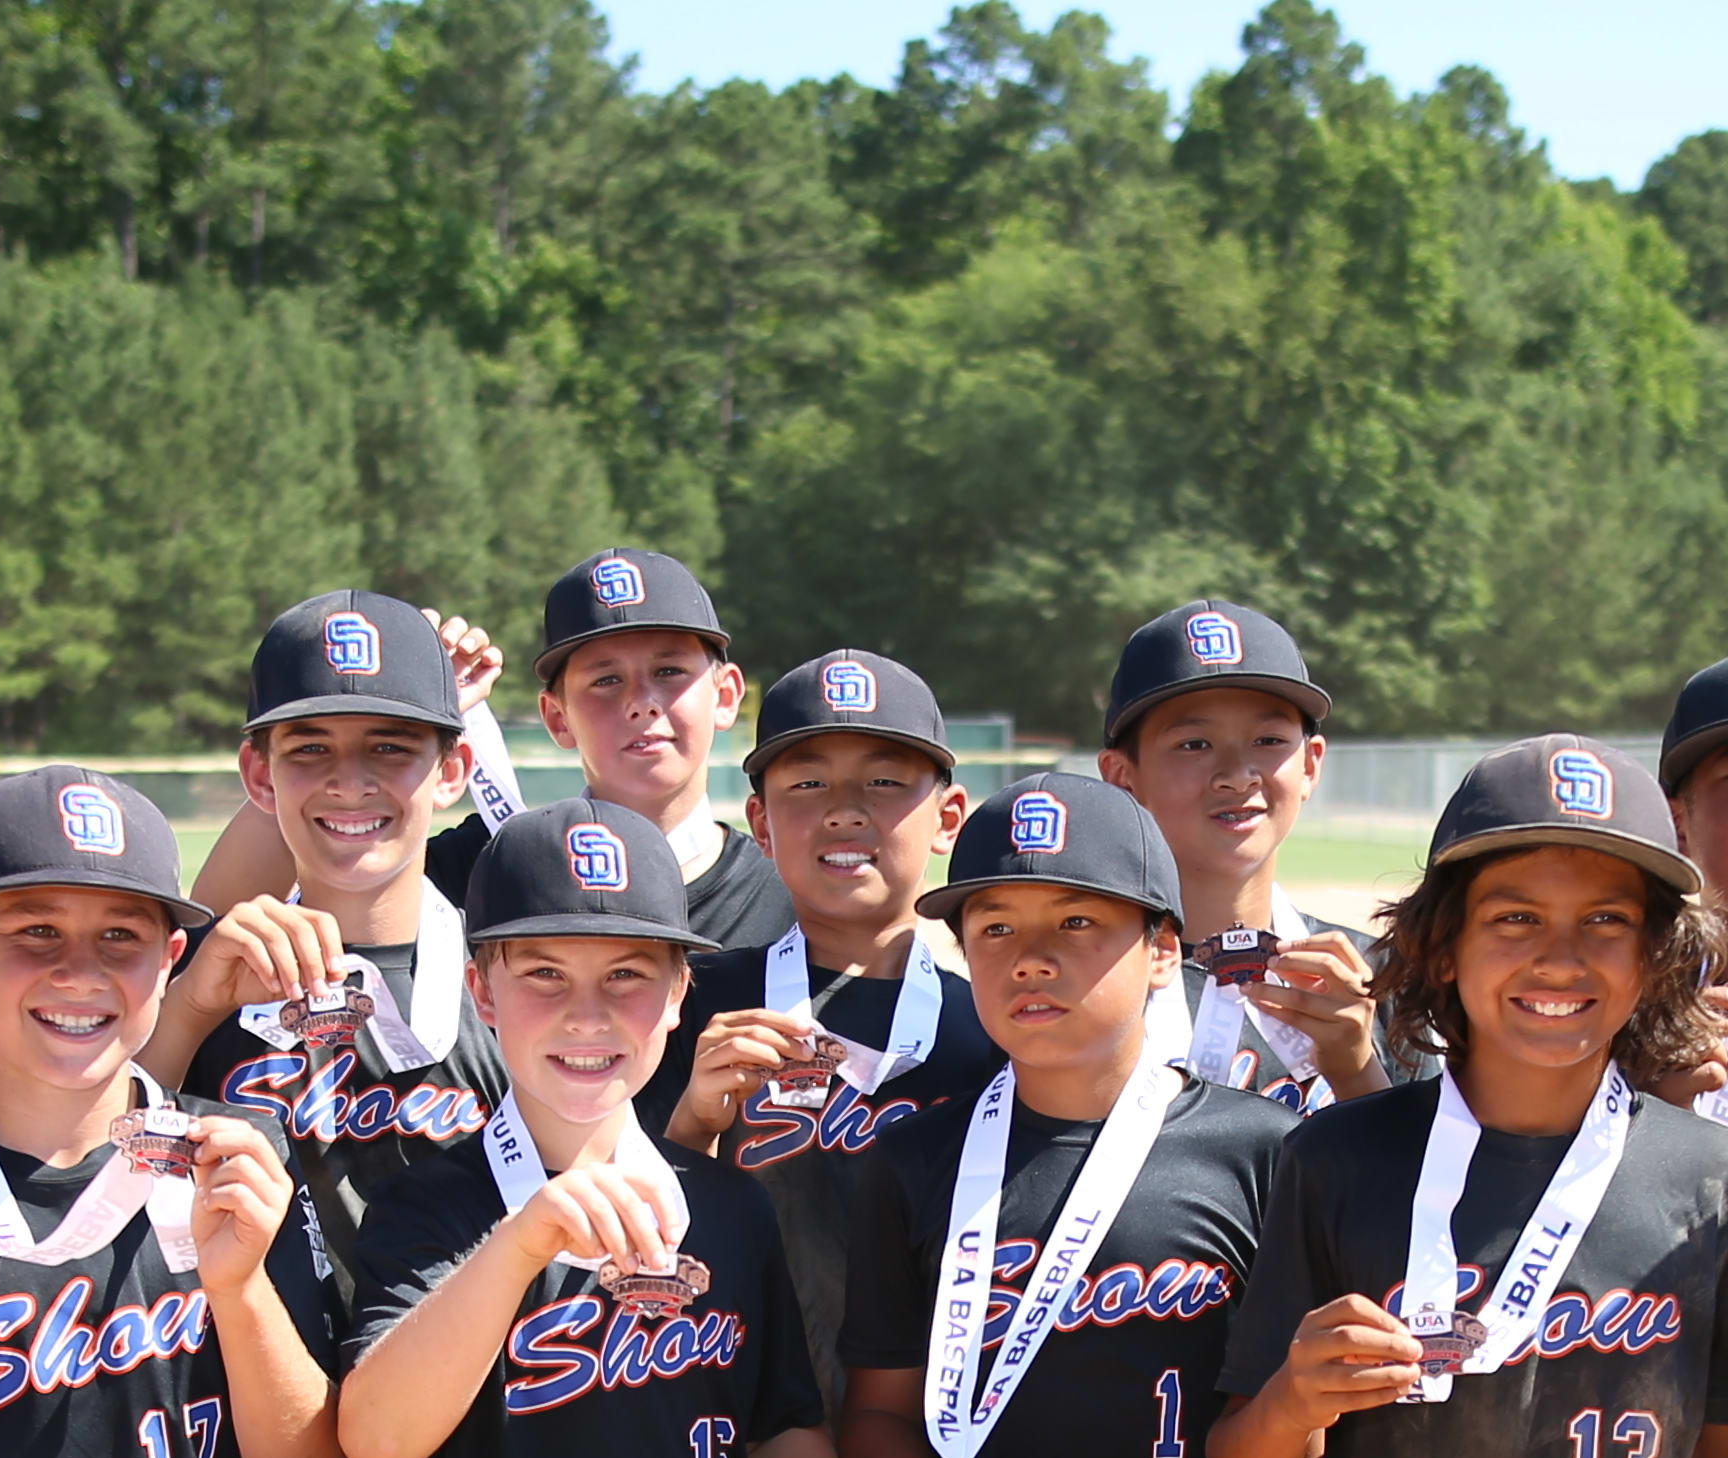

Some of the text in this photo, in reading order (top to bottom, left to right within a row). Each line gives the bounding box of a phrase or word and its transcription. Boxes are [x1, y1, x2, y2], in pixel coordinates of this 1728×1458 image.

[472, 767, 515, 823] EBA
[220, 1049, 488, 1142] Show
[1005, 1209, 1102, 1367] BASEBALL
